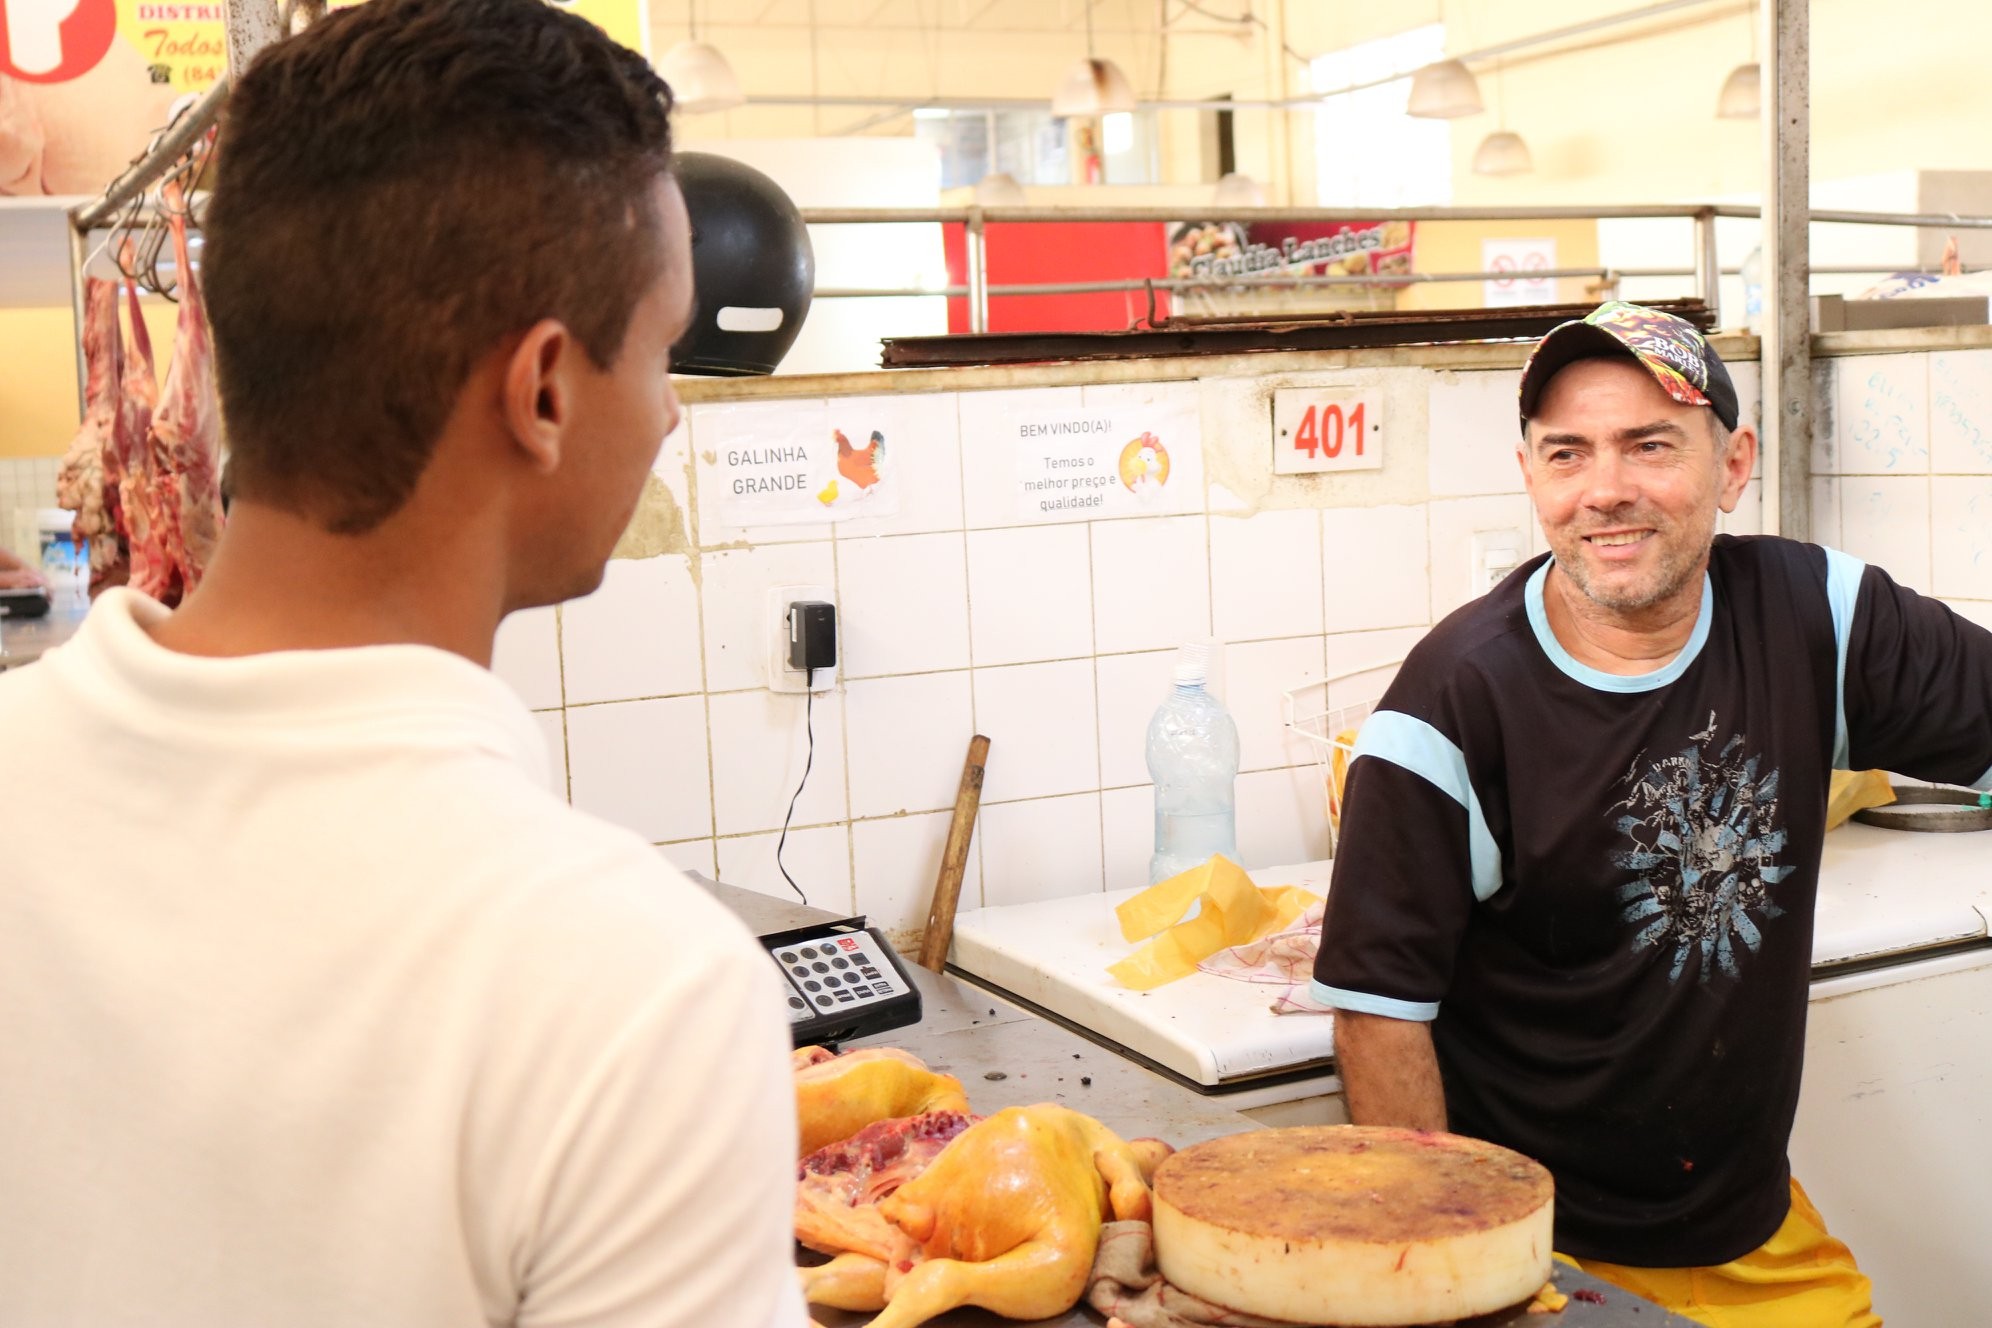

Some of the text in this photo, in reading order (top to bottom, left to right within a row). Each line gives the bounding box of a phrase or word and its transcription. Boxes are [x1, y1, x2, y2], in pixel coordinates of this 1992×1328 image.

[139, 5, 221, 19] DISTRI
[143, 29, 223, 57] Todos
[184, 64, 218, 86] (84
[1282, 226, 1382, 265] Lanches
[1653, 337, 1700, 368] BOB
[1020, 419, 1112, 438] BEM VINDO(A)!
[1294, 402, 1364, 458] 401
[727, 446, 808, 467] GALINHA
[1043, 456, 1095, 469] Temos o
[732, 473, 807, 495] GRANDE
[1024, 475, 1117, 491] melhor preço e
[1039, 493, 1104, 513] qualidade!
